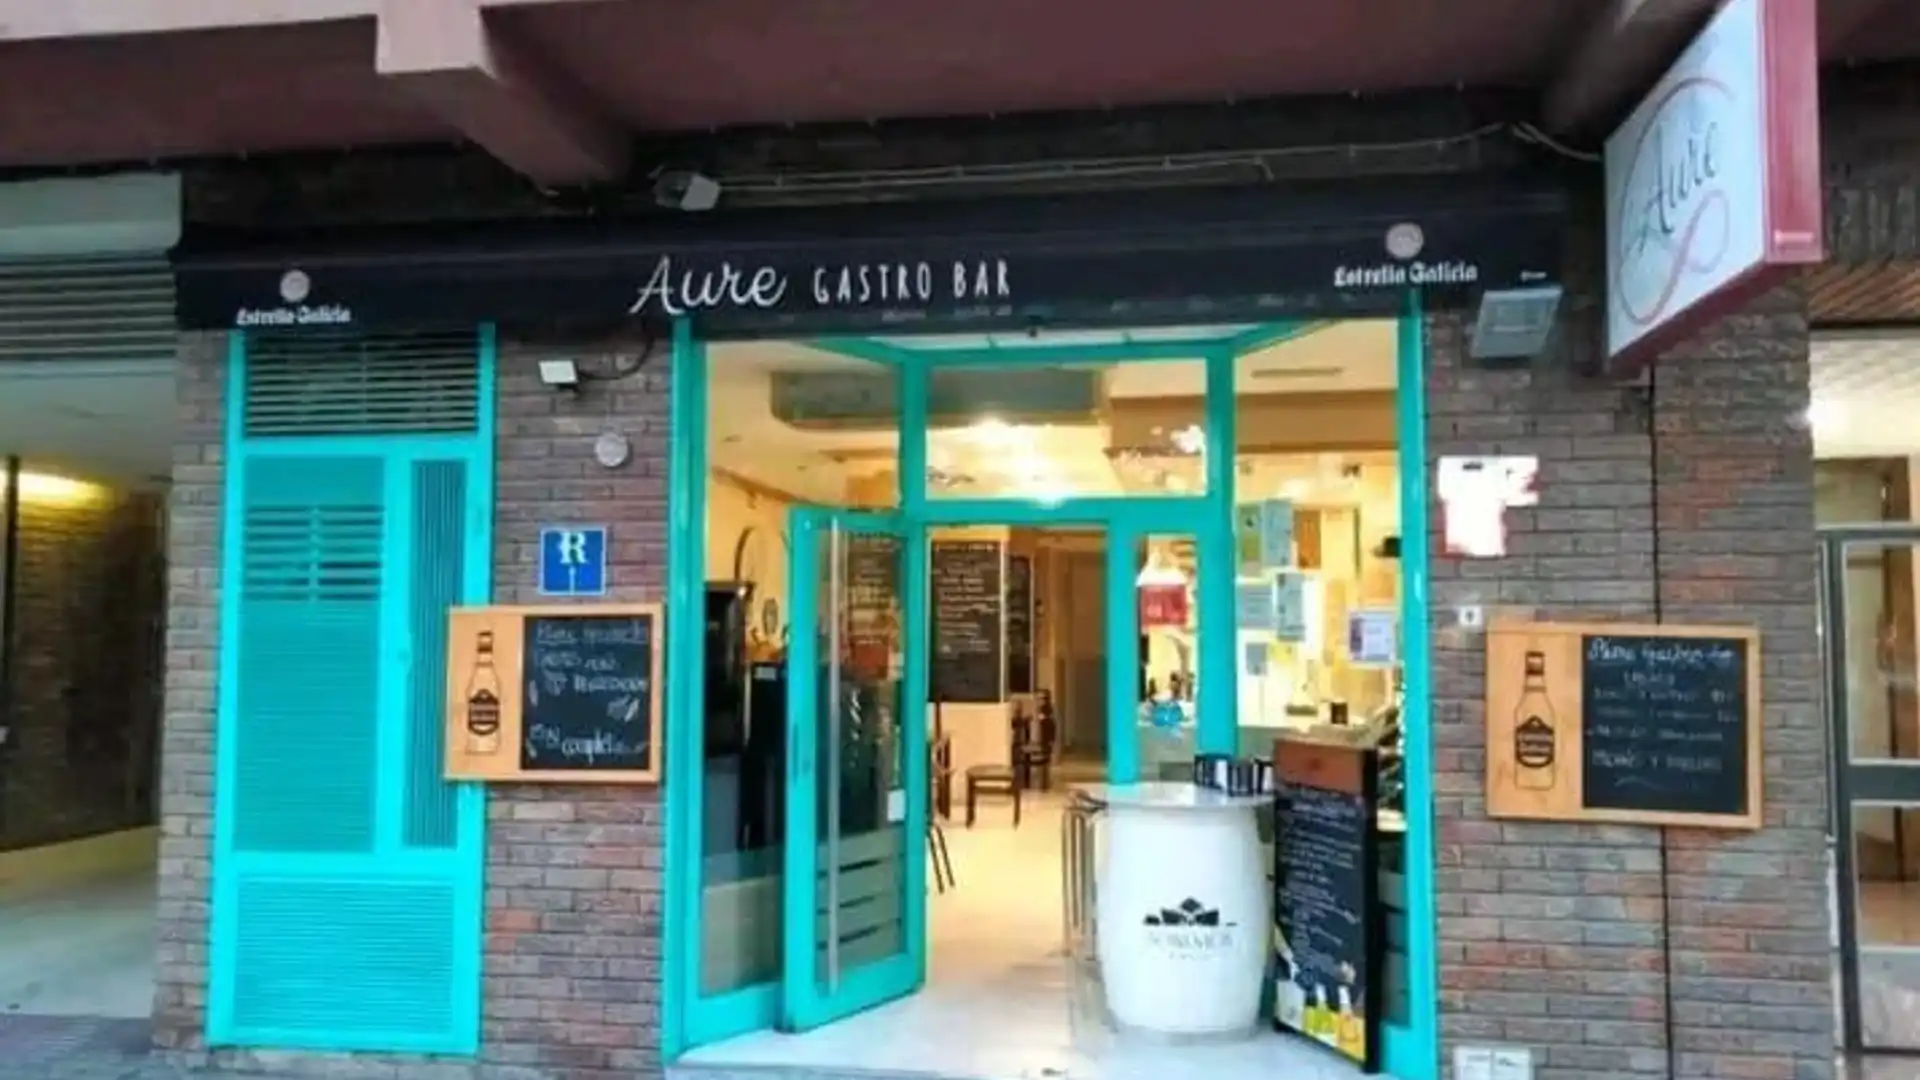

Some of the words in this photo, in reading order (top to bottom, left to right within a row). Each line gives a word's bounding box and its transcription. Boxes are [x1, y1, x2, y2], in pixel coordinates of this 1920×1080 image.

[628, 253, 788, 315] Aure
[812, 262, 933, 304] GASTRO
[952, 259, 1011, 299] BAR
[560, 530, 588, 565] R
